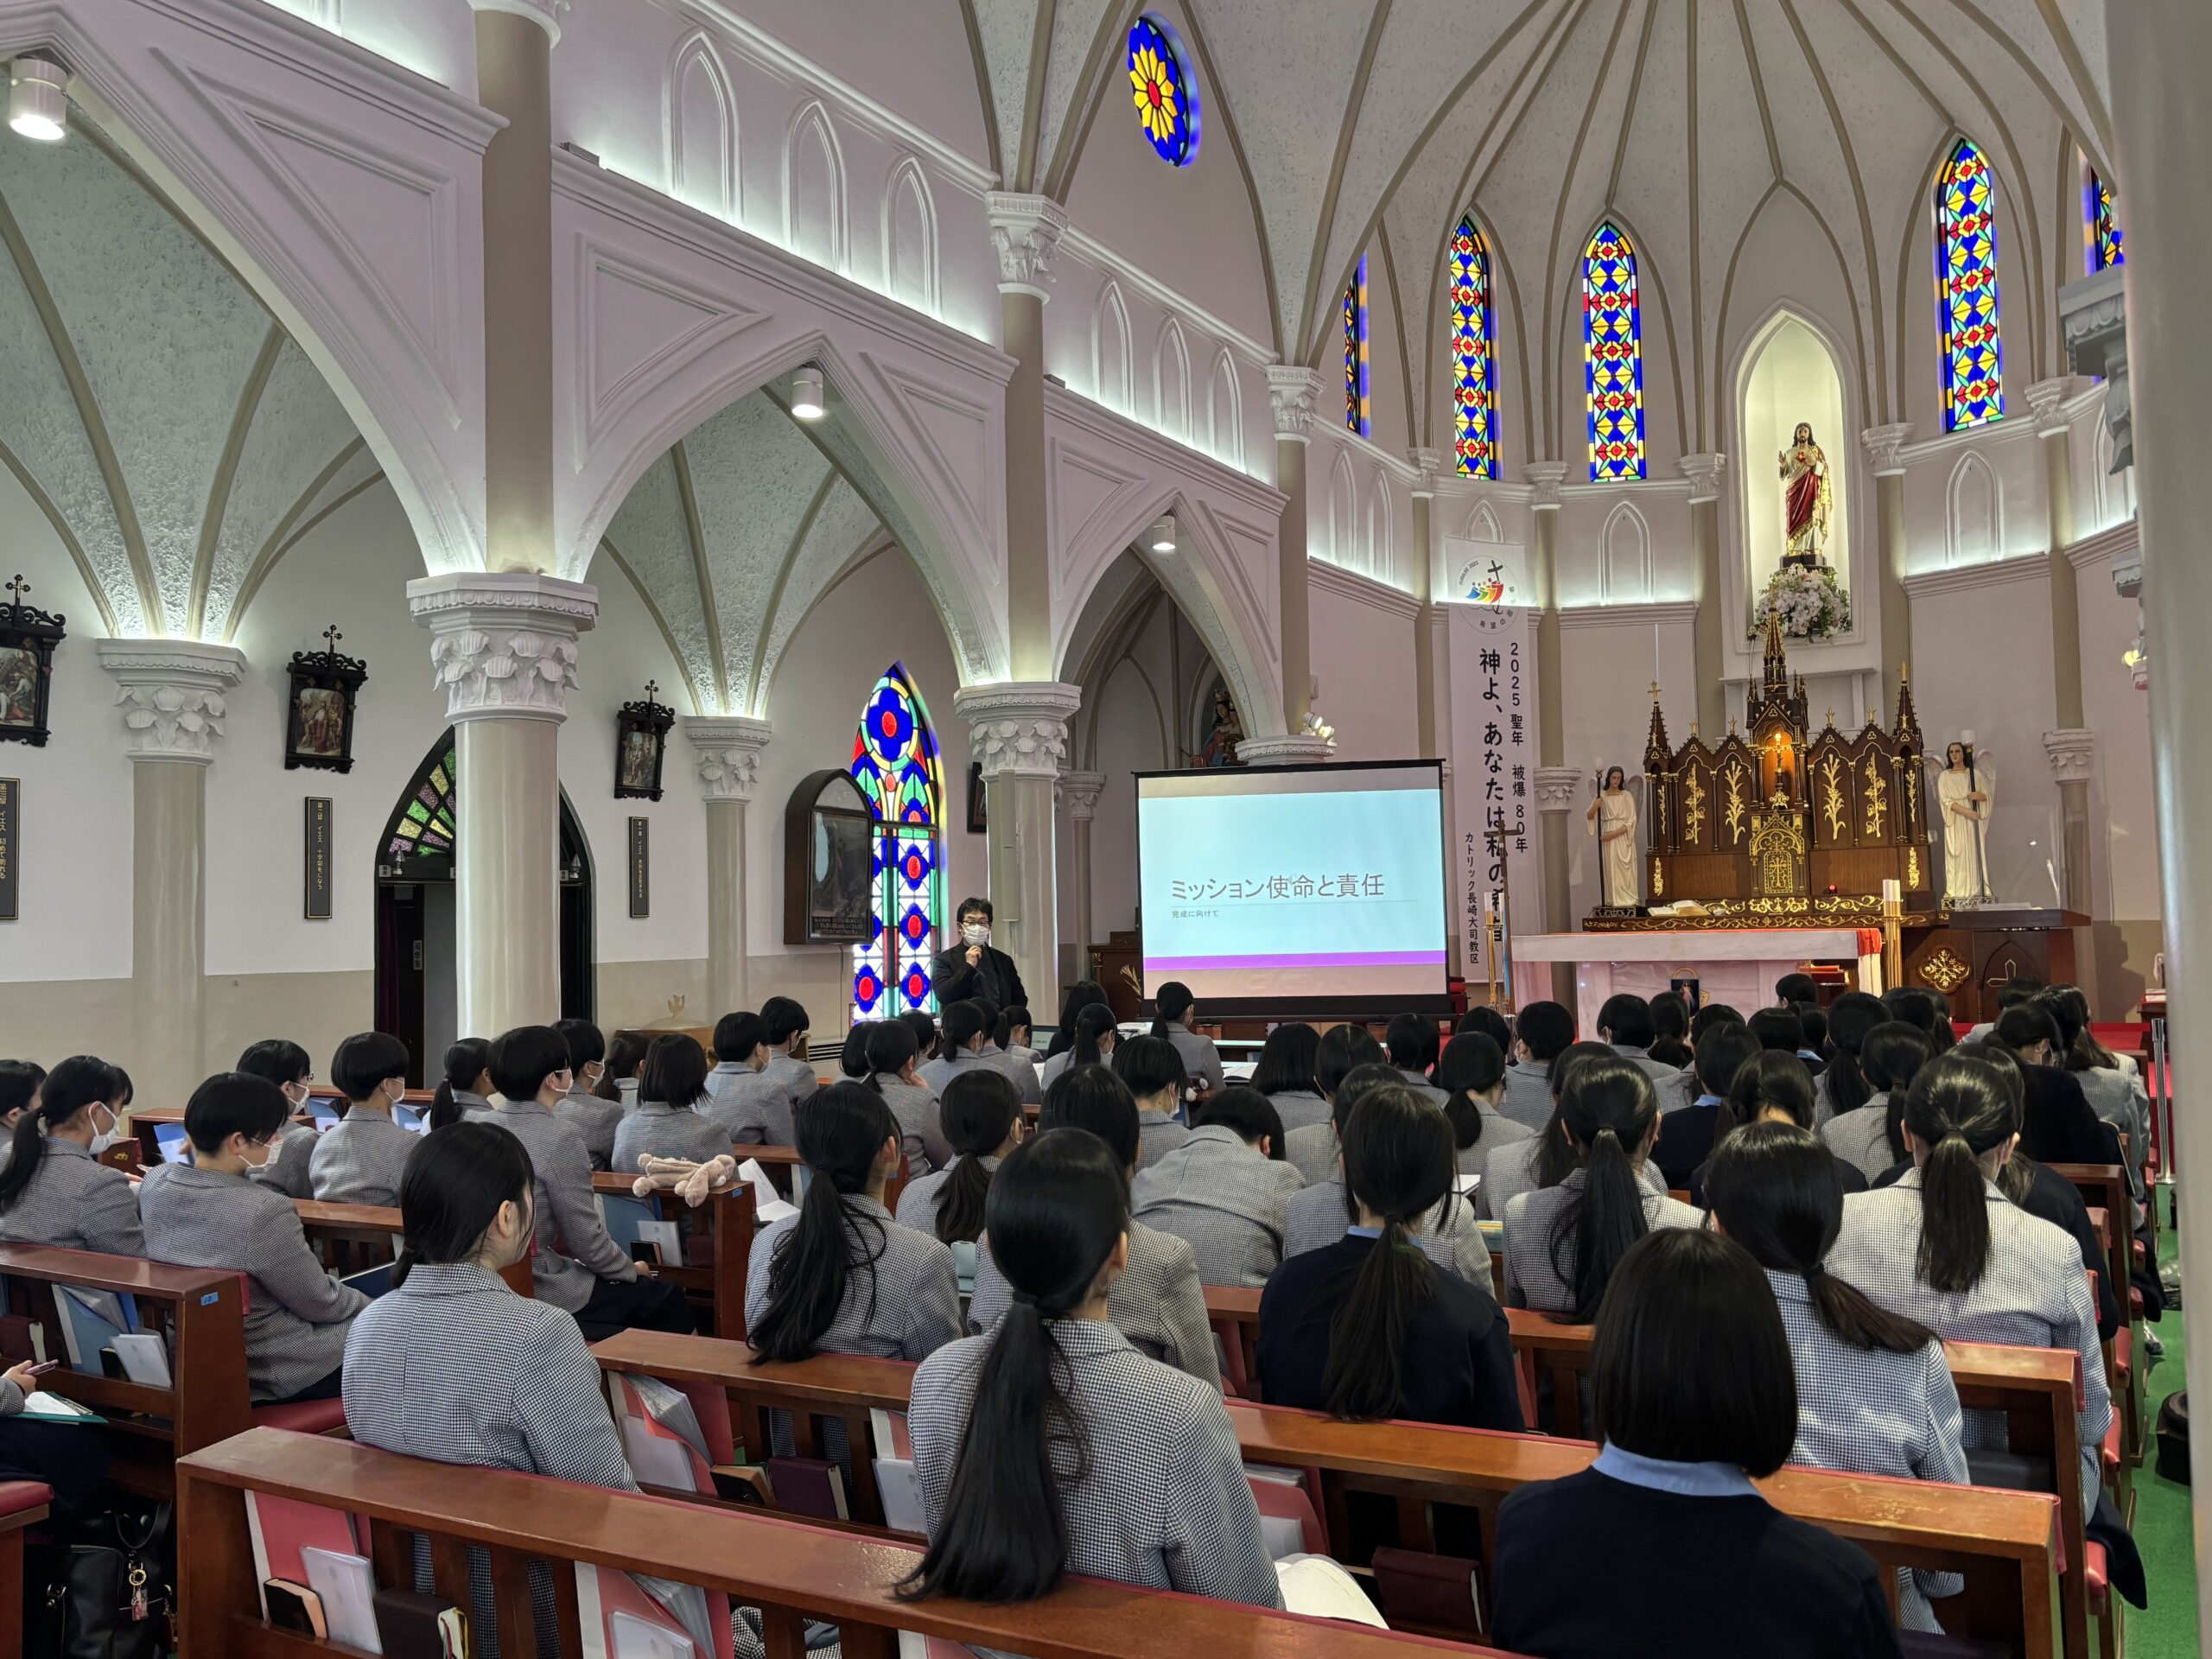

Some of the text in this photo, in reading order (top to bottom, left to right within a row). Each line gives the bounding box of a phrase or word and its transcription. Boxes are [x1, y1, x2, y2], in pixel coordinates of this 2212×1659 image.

[1510, 642, 1528, 854] 2025聖年 被爆80年
[1172, 873, 1385, 900] ミッション使命と責任
[1172, 910, 1219, 918] 完成に向けて
[1465, 832, 1478, 964] カトリック長崎大司教区
